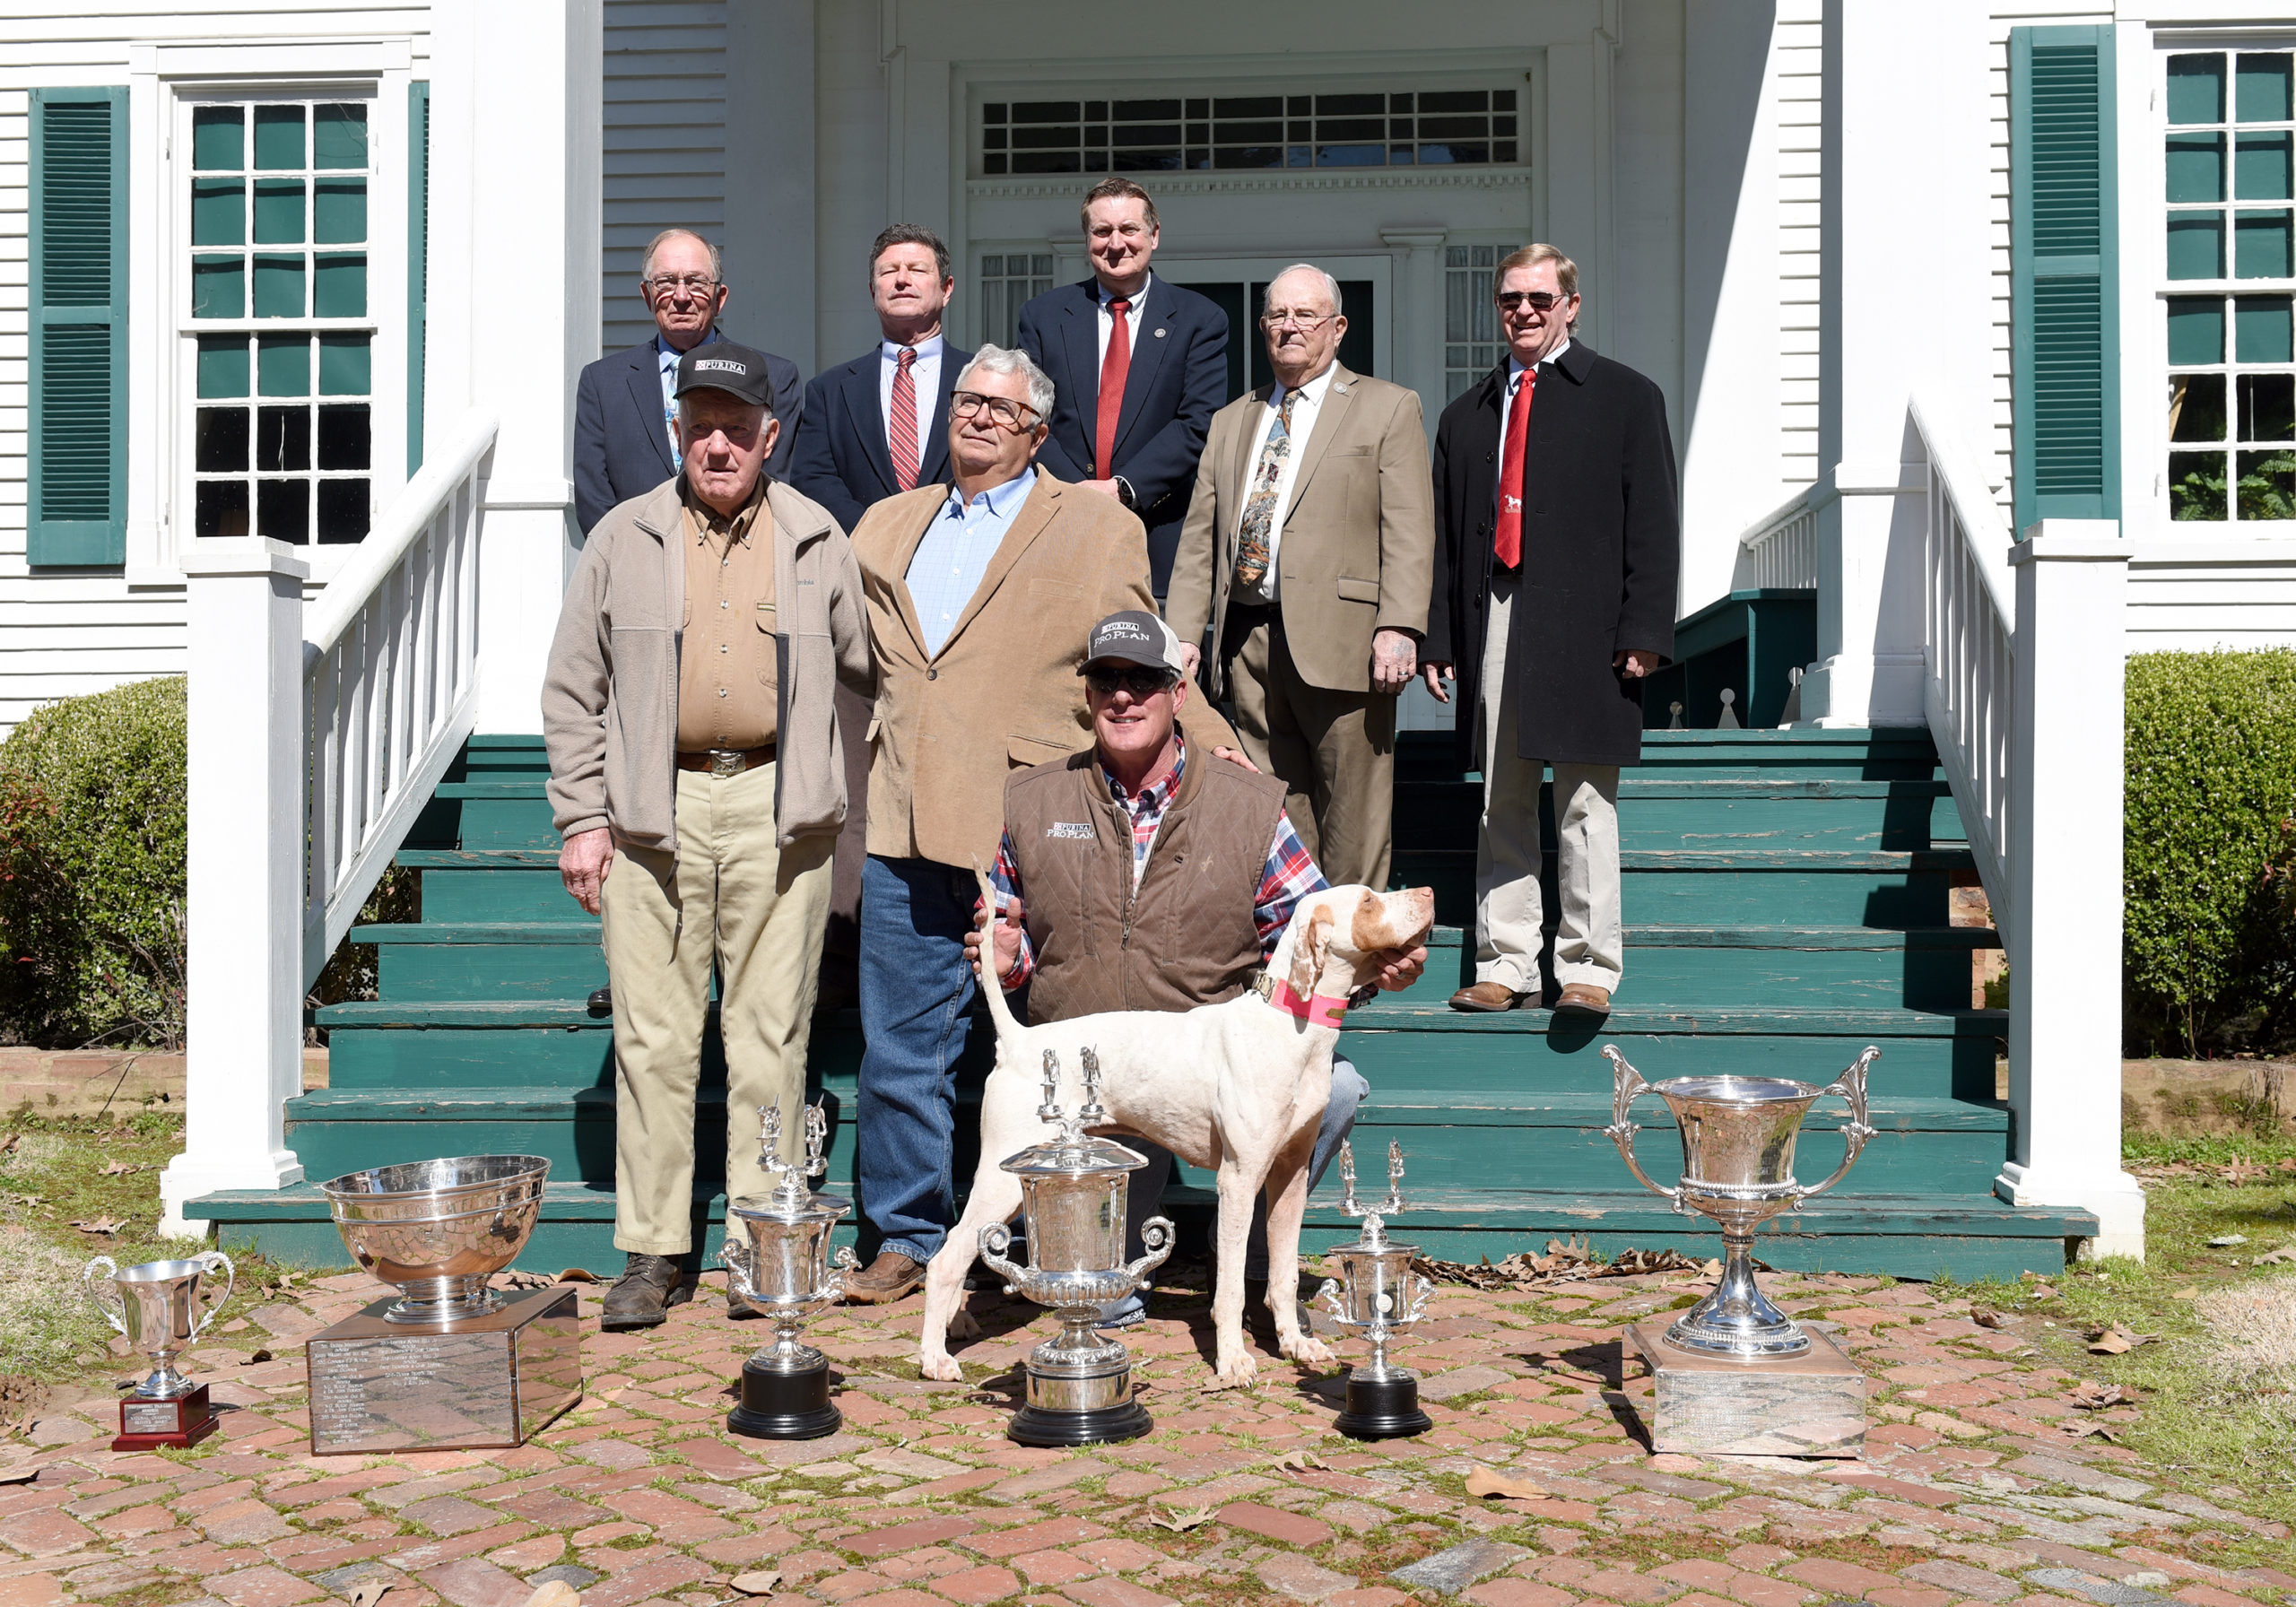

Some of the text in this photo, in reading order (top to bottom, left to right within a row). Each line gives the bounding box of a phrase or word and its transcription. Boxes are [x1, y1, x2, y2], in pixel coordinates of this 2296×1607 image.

[705, 360, 744, 373] PURINA
[1108, 623, 1137, 631] PURINA
[1094, 631, 1150, 647] PRO PLAN
[1047, 830, 1094, 839] PRO PLAN
